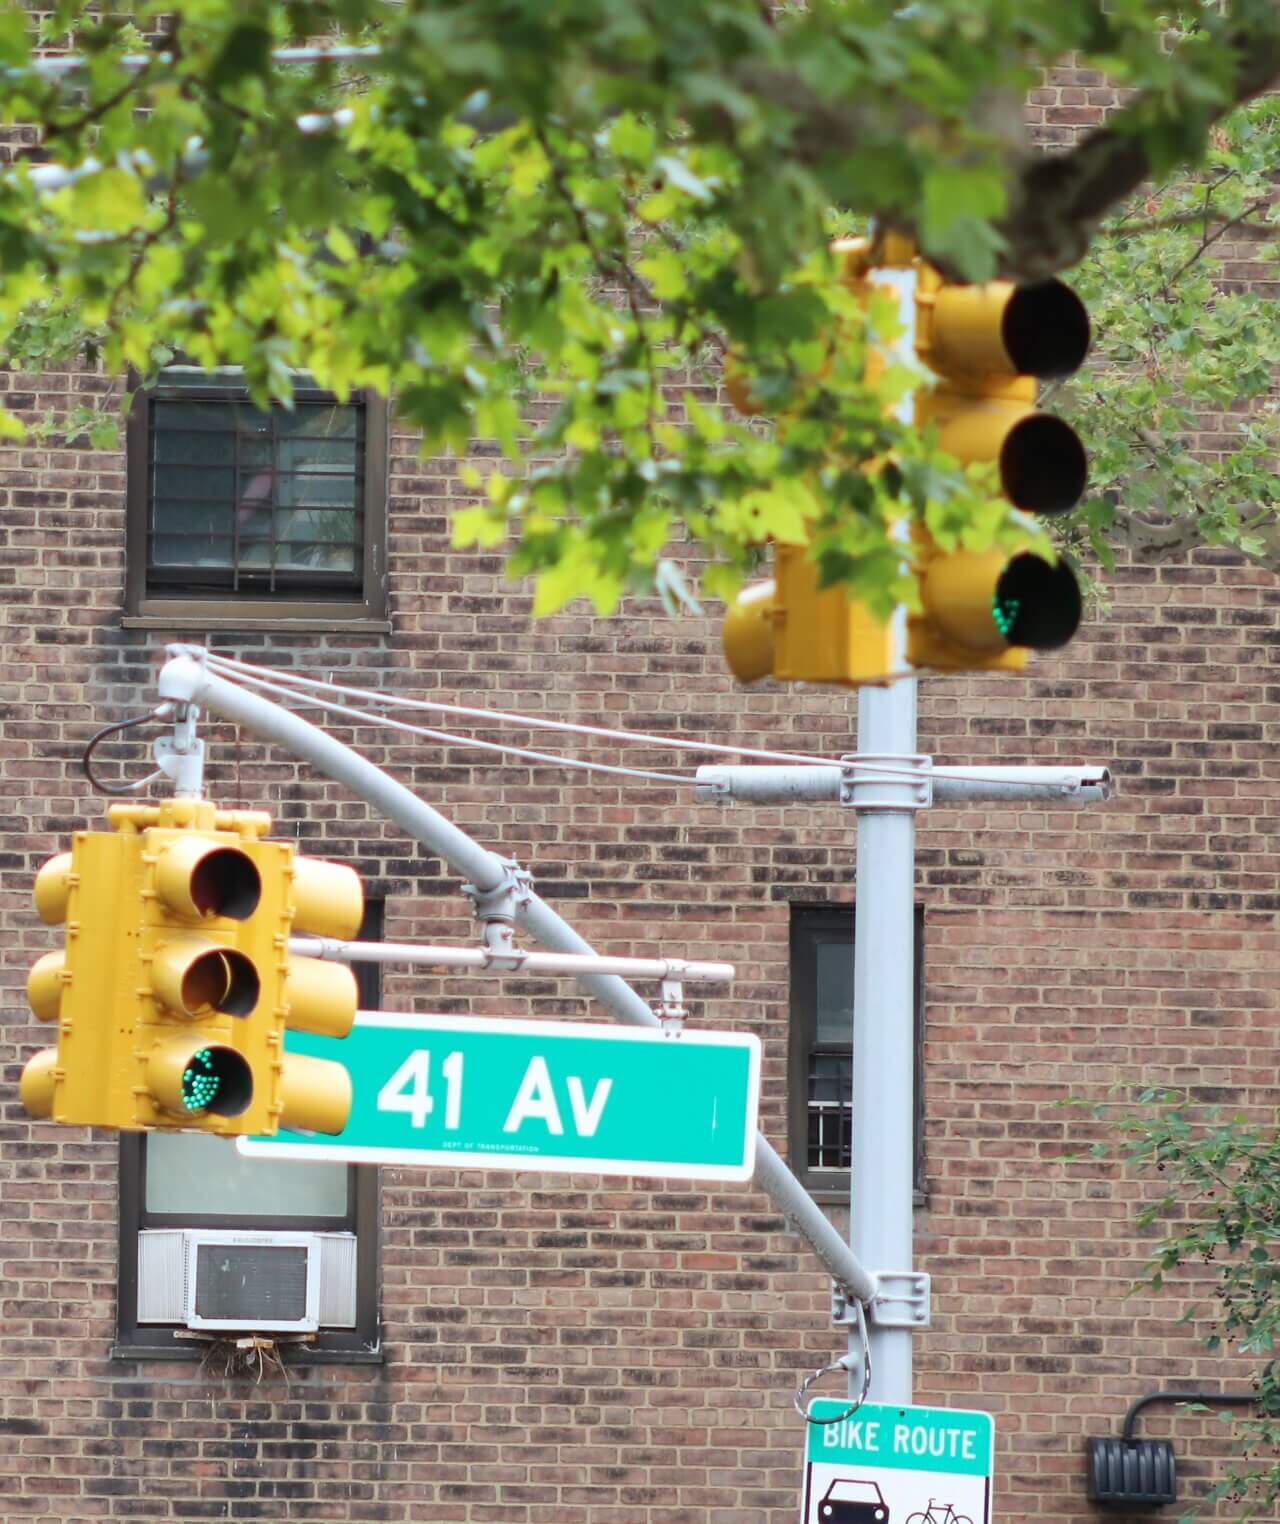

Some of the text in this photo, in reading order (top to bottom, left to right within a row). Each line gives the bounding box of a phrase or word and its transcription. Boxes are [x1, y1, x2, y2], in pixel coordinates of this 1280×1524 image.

[377, 1048, 613, 1137] 41 Av
[442, 1141, 539, 1153] DEPT OF TRANSPORTATION
[823, 1420, 977, 1460] BIKE ROUTE
